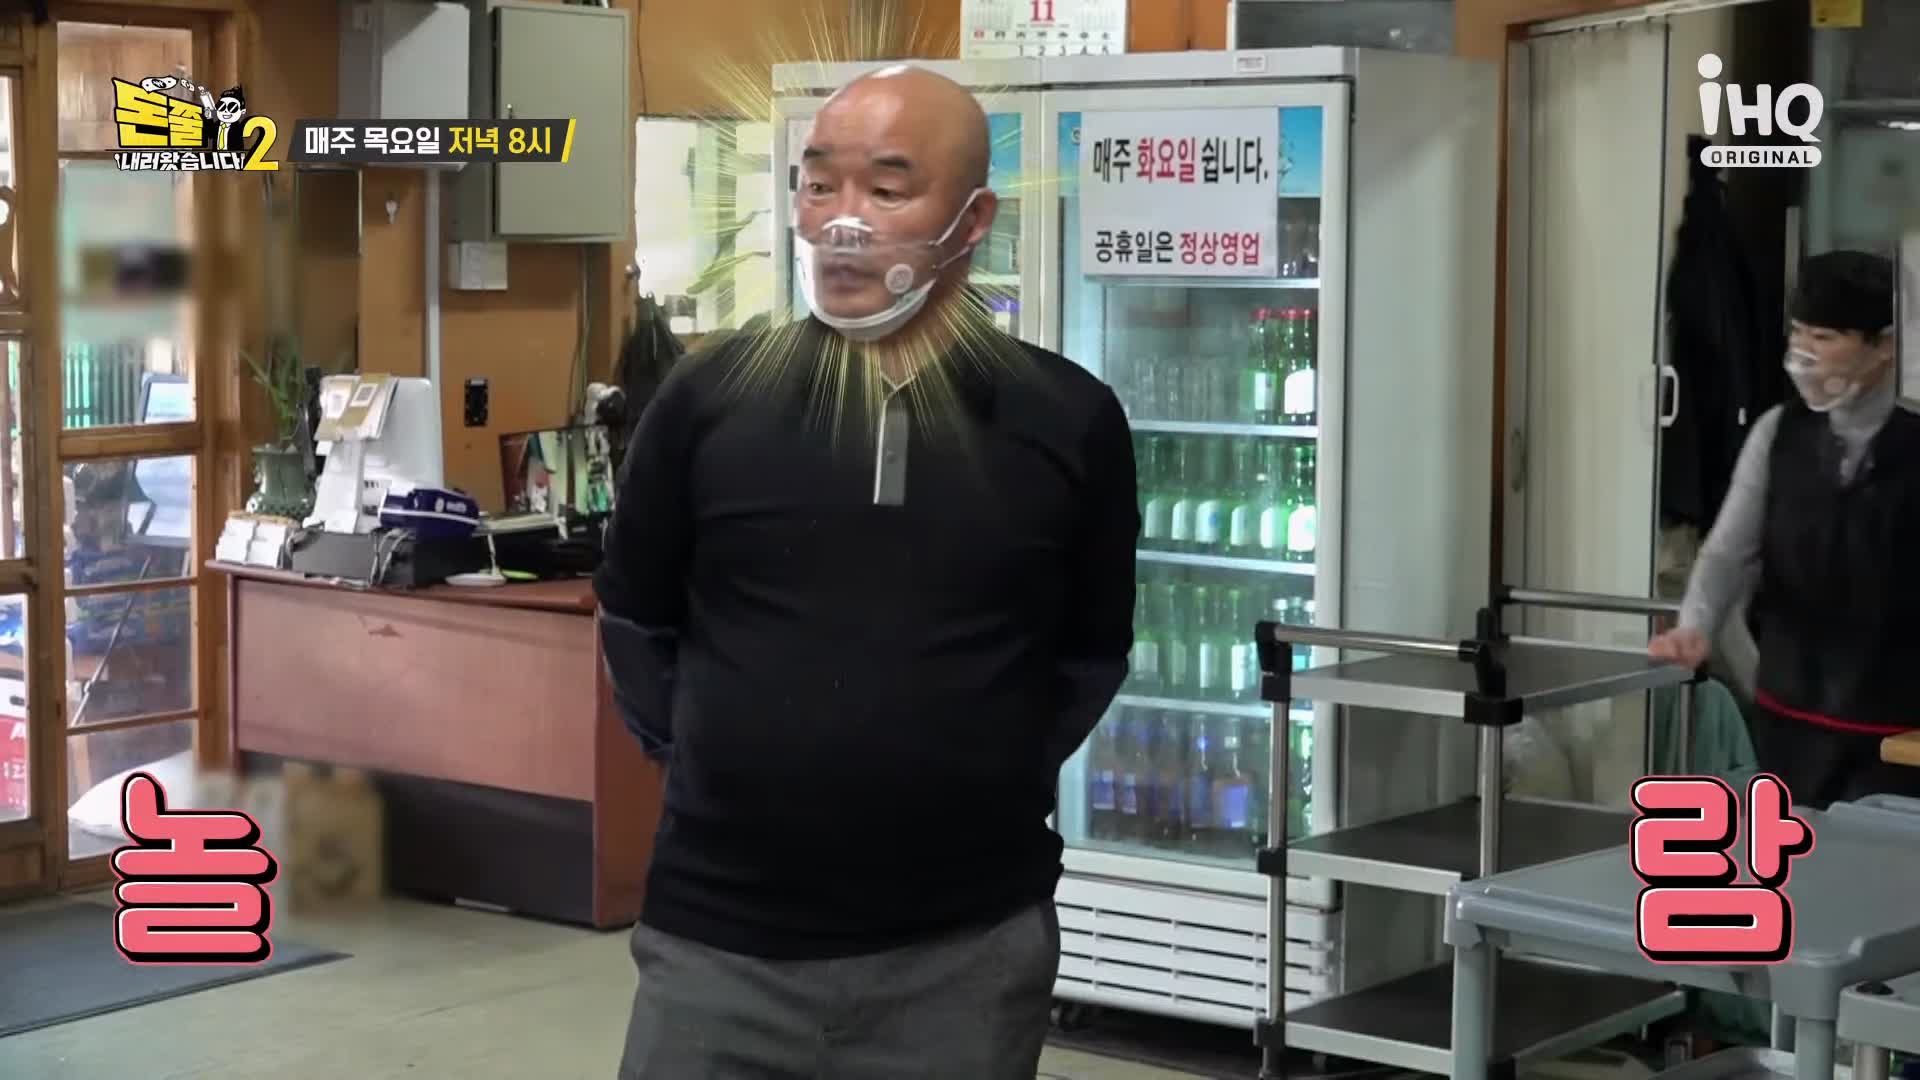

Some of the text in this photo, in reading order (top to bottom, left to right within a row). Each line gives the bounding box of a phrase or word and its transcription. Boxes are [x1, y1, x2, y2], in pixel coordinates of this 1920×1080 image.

[1030, 0, 1055, 22] 11
[1093, 137, 1269, 184] 매주 화요일 쉽니다.
[1095, 230, 1260, 266] 공휴일은 정상영업
